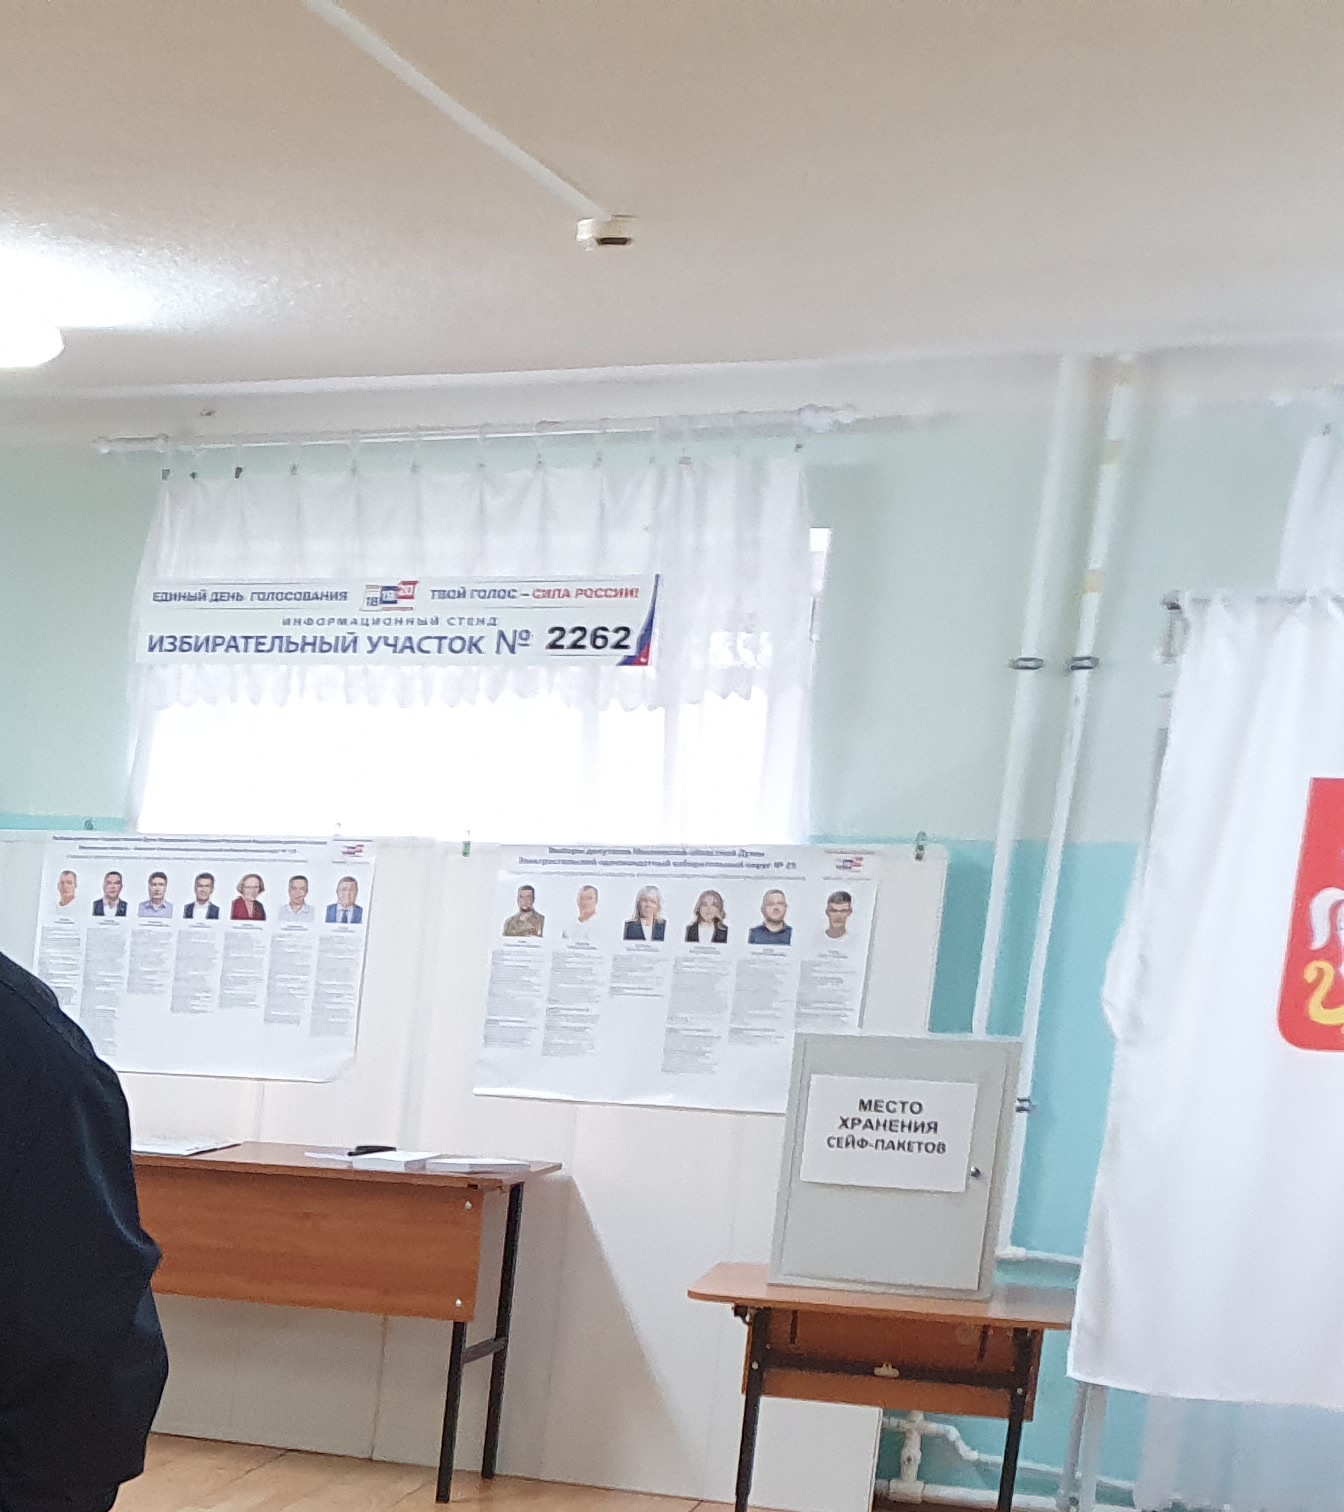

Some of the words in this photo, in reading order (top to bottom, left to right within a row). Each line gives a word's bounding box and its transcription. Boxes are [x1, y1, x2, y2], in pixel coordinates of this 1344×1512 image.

[153, 588, 207, 602] ЕДИНЫЙ
[209, 591, 244, 603] ДЕНЬ
[250, 590, 348, 602] ГОЛОСОВАНИЯ
[430, 587, 467, 599] ТВОЙ
[470, 588, 518, 600] ГОЛОС
[532, 588, 571, 600] СИЛА
[281, 616, 440, 627] ИНФОРМАЦИОННЫЙ
[446, 616, 499, 627] СТЕНД
[147, 632, 359, 654] ИЗБИРАТЕЛЬНЫЙ
[366, 634, 485, 655] УЧАСТОК
[495, 628, 533, 655] №
[545, 625, 632, 651] 2262
[858, 1098, 923, 1115] МЕСТО
[838, 1116, 939, 1135] ХРАНЕНИЯ
[826, 1134, 947, 1155] СЕЙФ-ПАКЕТОВ
